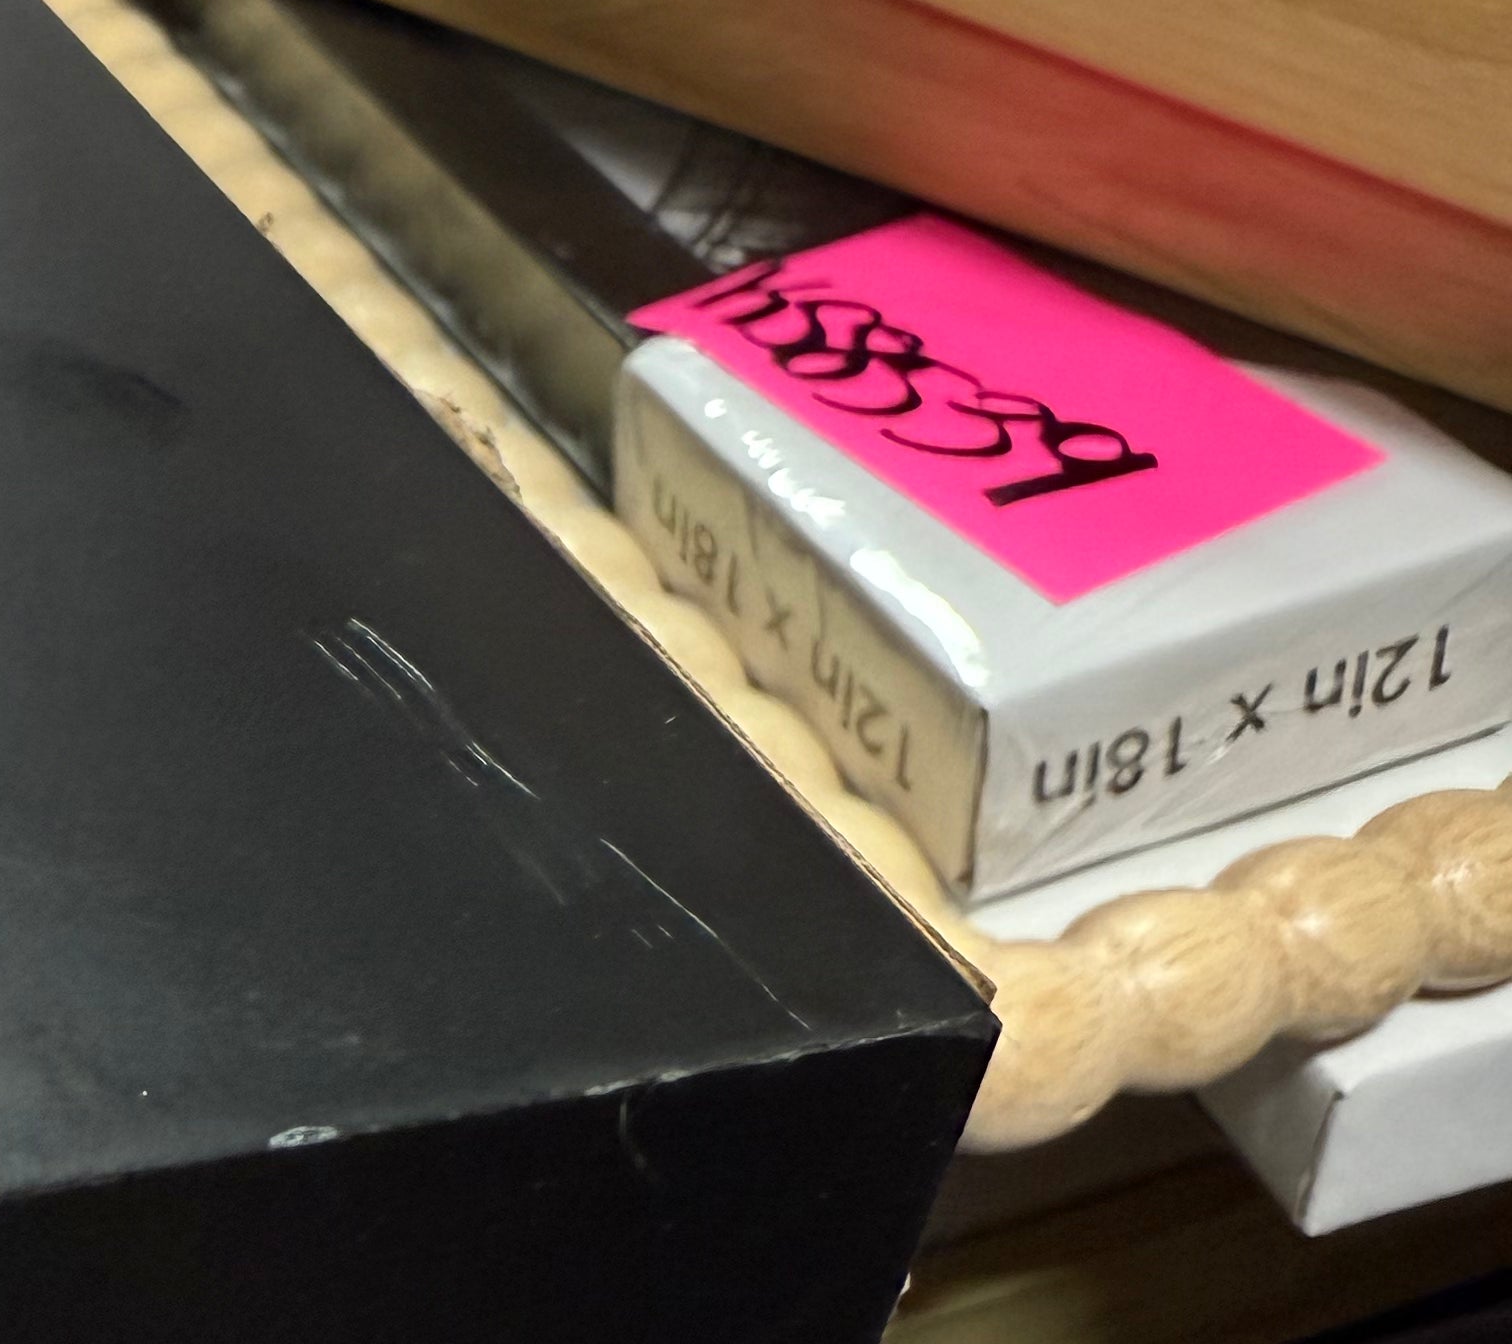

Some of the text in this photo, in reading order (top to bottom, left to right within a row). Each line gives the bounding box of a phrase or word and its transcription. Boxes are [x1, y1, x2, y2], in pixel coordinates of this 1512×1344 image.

[651, 473, 912, 793] 12in x 18in
[1031, 623, 1453, 804] 12in x 18in
